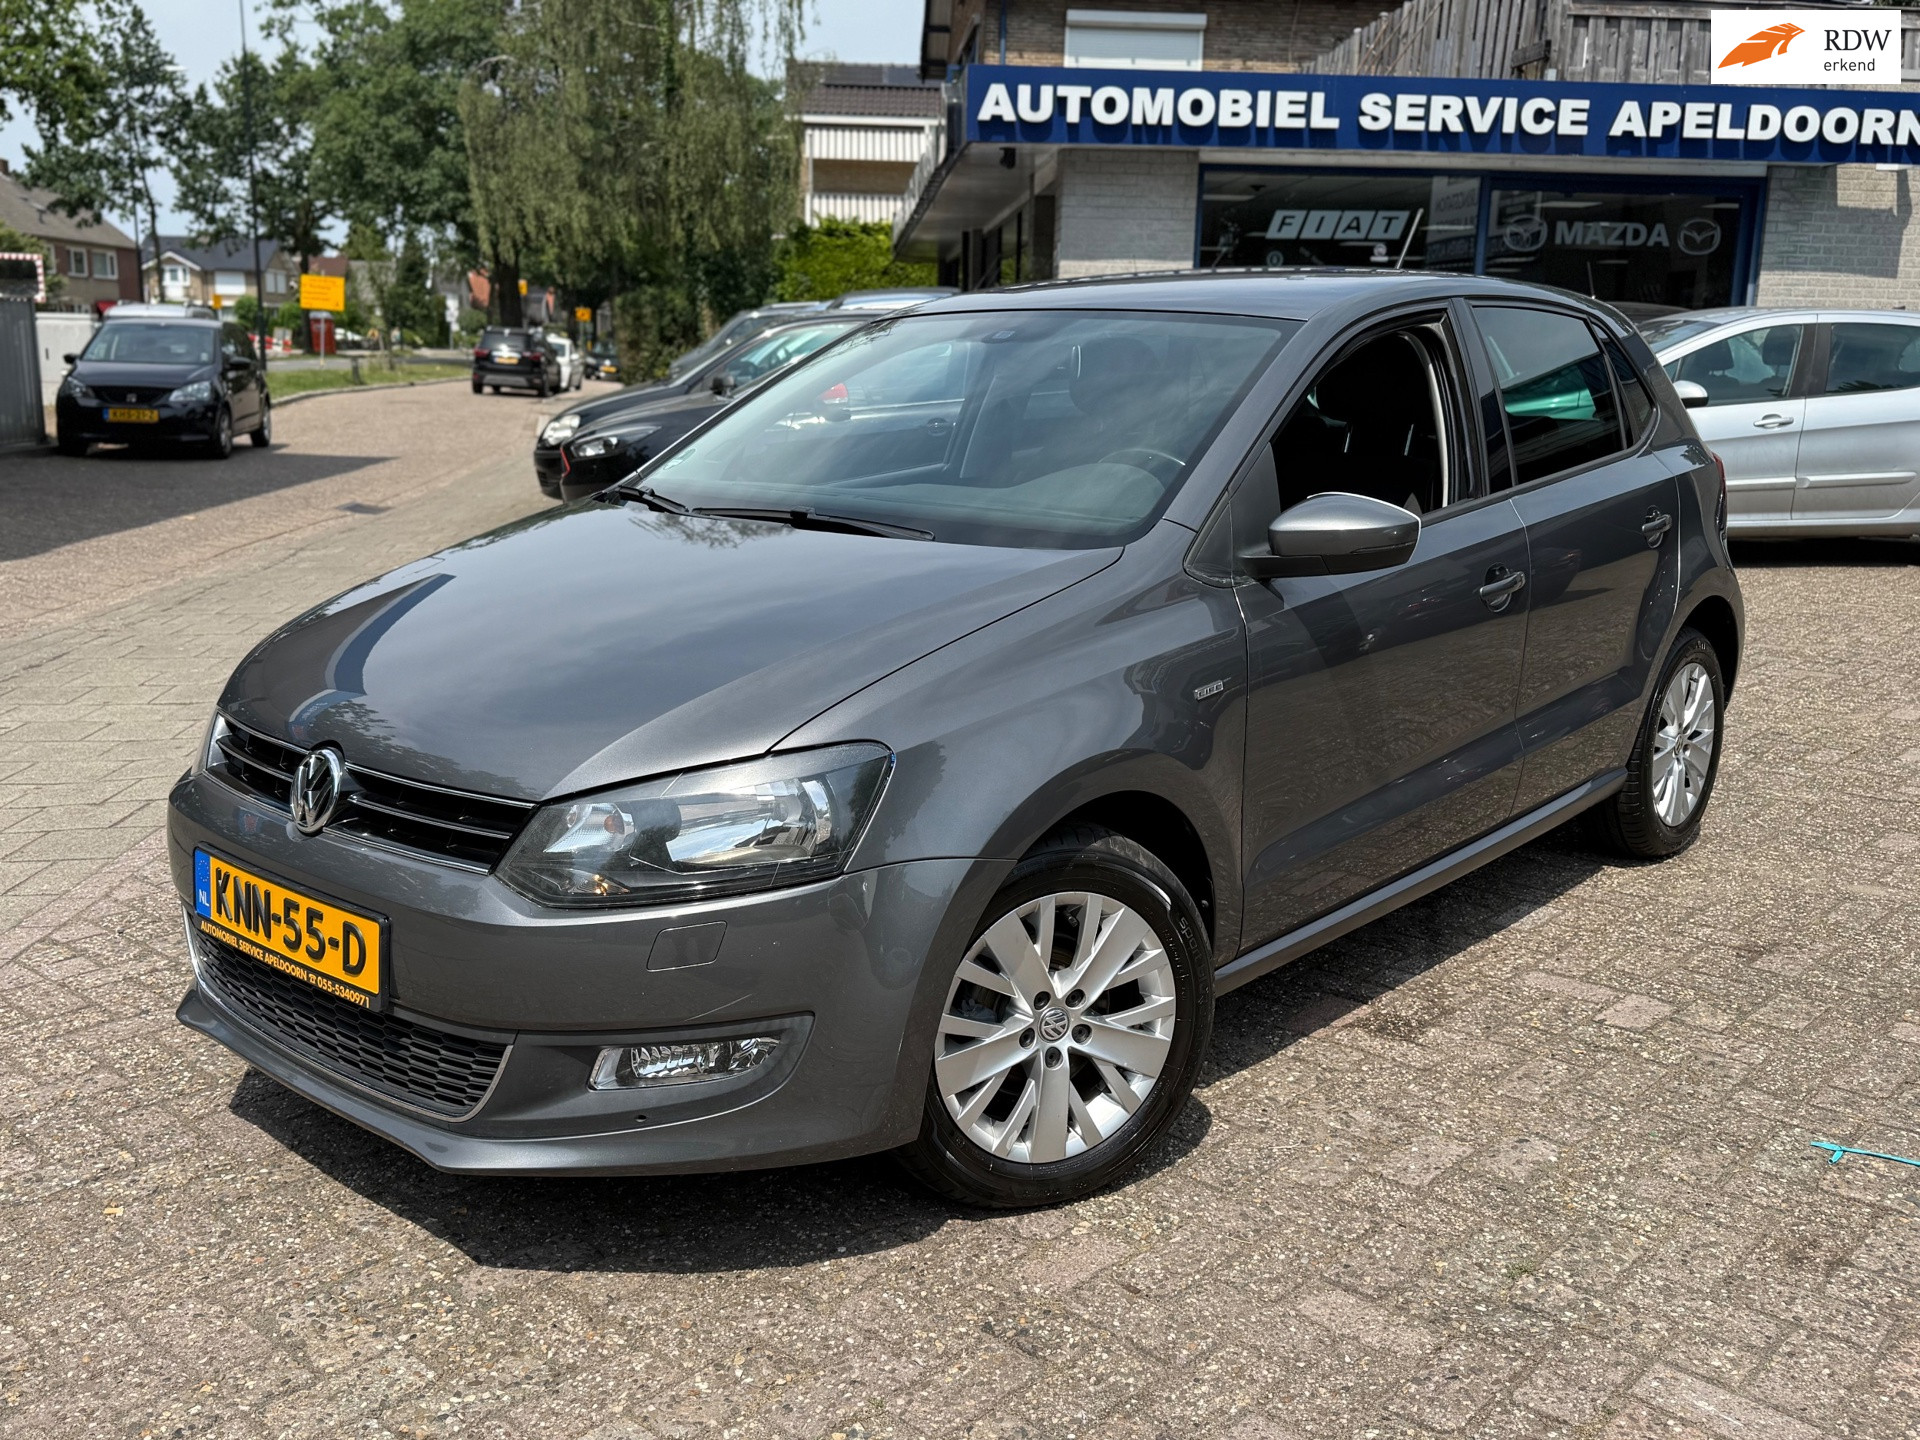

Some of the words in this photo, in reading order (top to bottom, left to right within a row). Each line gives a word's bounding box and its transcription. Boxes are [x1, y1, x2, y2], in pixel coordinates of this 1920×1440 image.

[977, 83, 1340, 130] AUTOMOBIEL
[1359, 93, 1590, 136] SERVICE
[1608, 101, 1920, 146] APELDOORN
[1275, 213, 1401, 235] FIAT
[1554, 220, 1670, 248] MAZDA
[198, 888, 210, 907] NL
[215, 867, 367, 977] KNN-55-D
[200, 920, 239, 948] AUTOMOBIEL
[238, 939, 264, 962] SERVICE
[264, 953, 308, 982] APELDOORN
[317, 975, 371, 1009] 055-5340971
